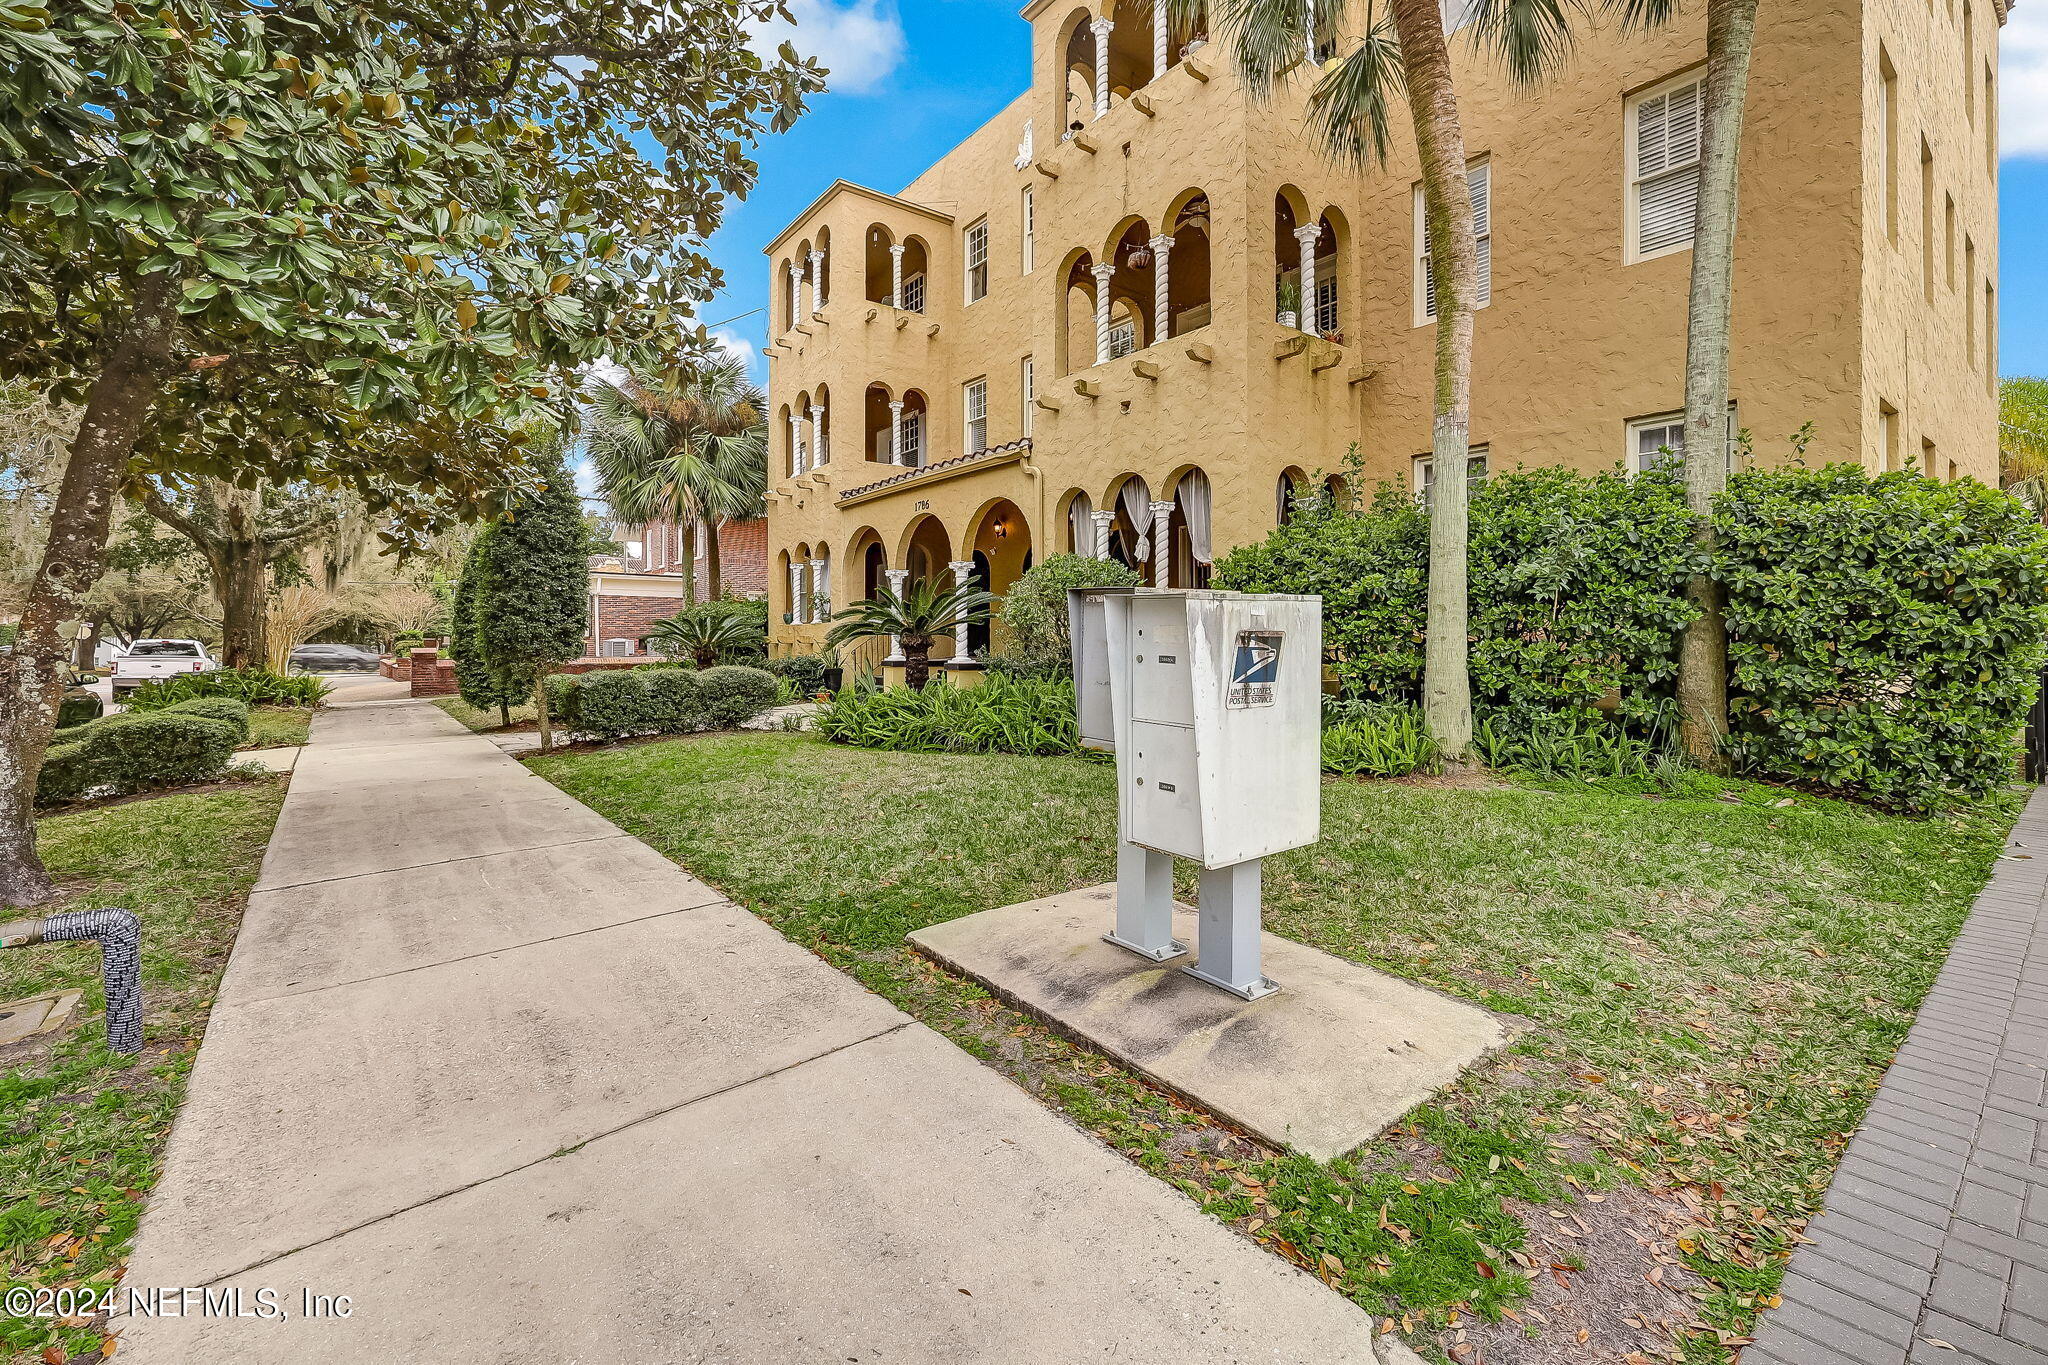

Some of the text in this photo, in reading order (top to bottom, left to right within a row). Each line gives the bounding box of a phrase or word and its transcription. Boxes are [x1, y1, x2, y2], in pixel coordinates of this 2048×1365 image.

[1230, 687, 1272, 696] UNITED STATES
[1229, 696, 1273, 705] POSTAL SERVICE
